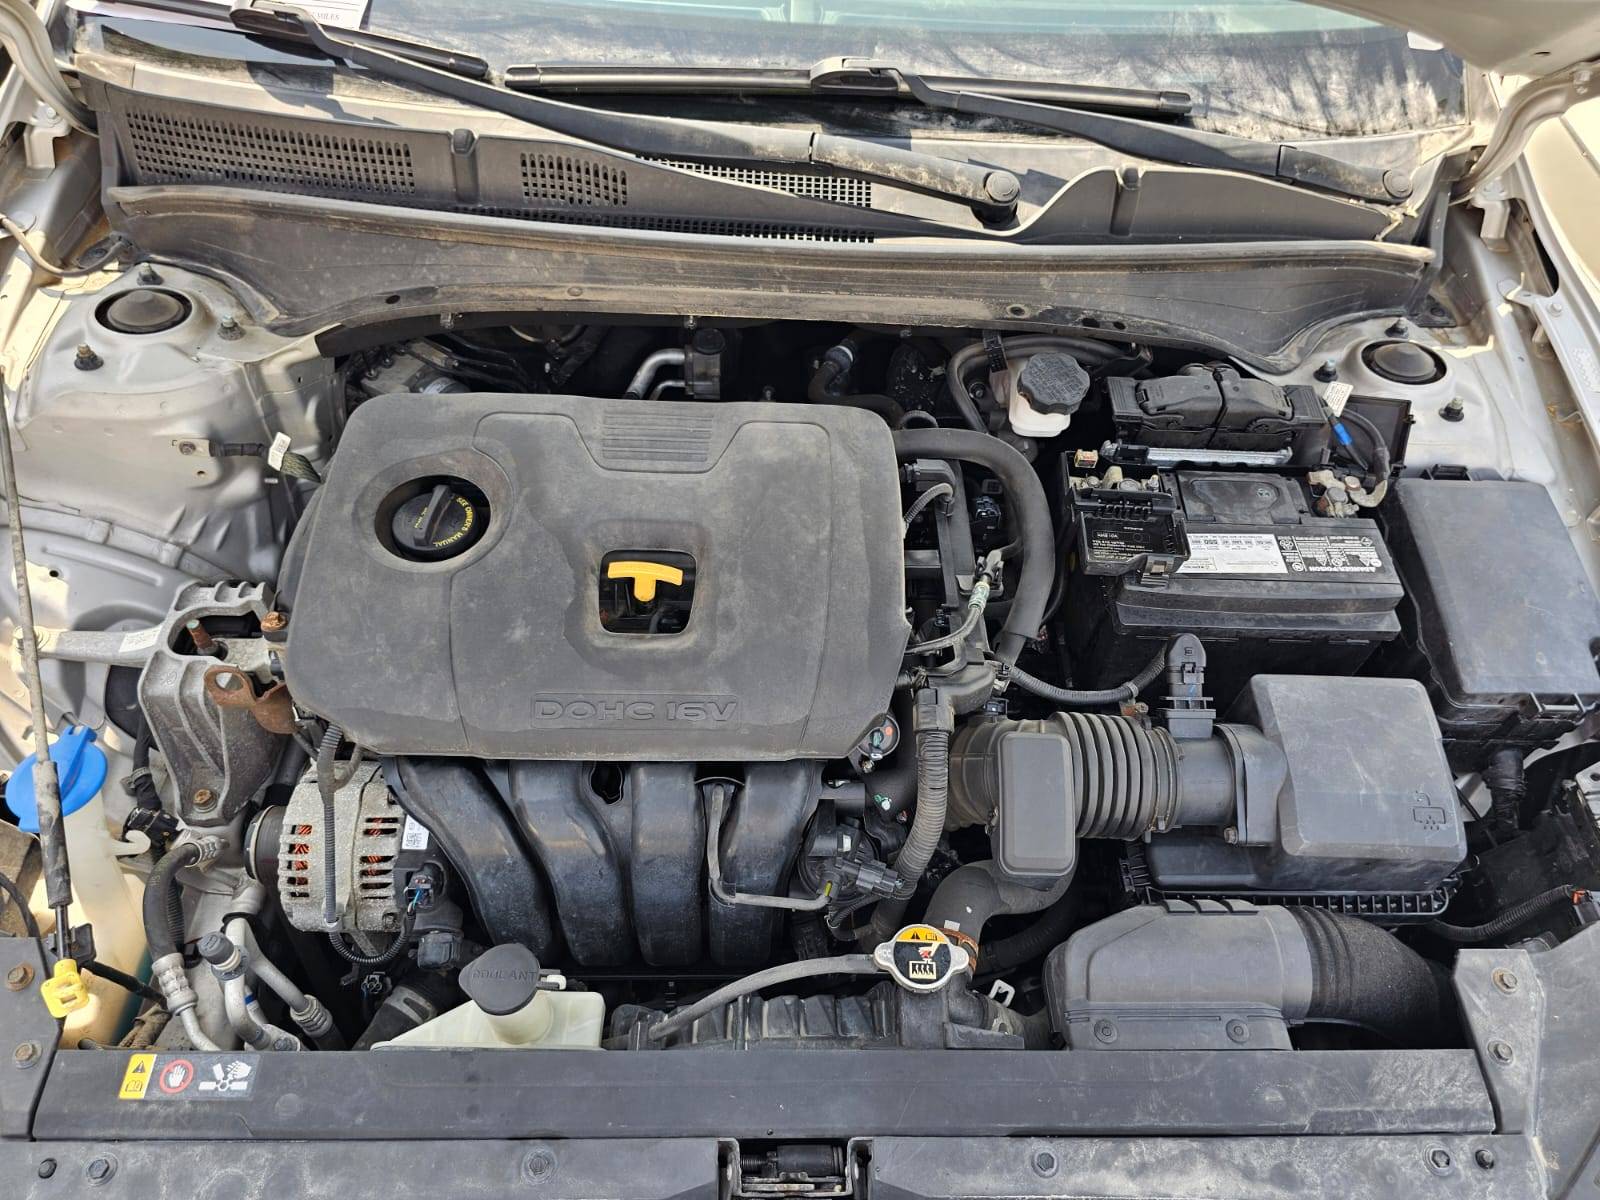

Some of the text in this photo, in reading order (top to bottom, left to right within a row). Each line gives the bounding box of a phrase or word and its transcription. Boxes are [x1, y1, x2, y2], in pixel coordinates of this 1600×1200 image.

[456, 497, 469, 507] SEE
[433, 531, 463, 548] MANUAL
[535, 699, 738, 722] DOHC 16V
